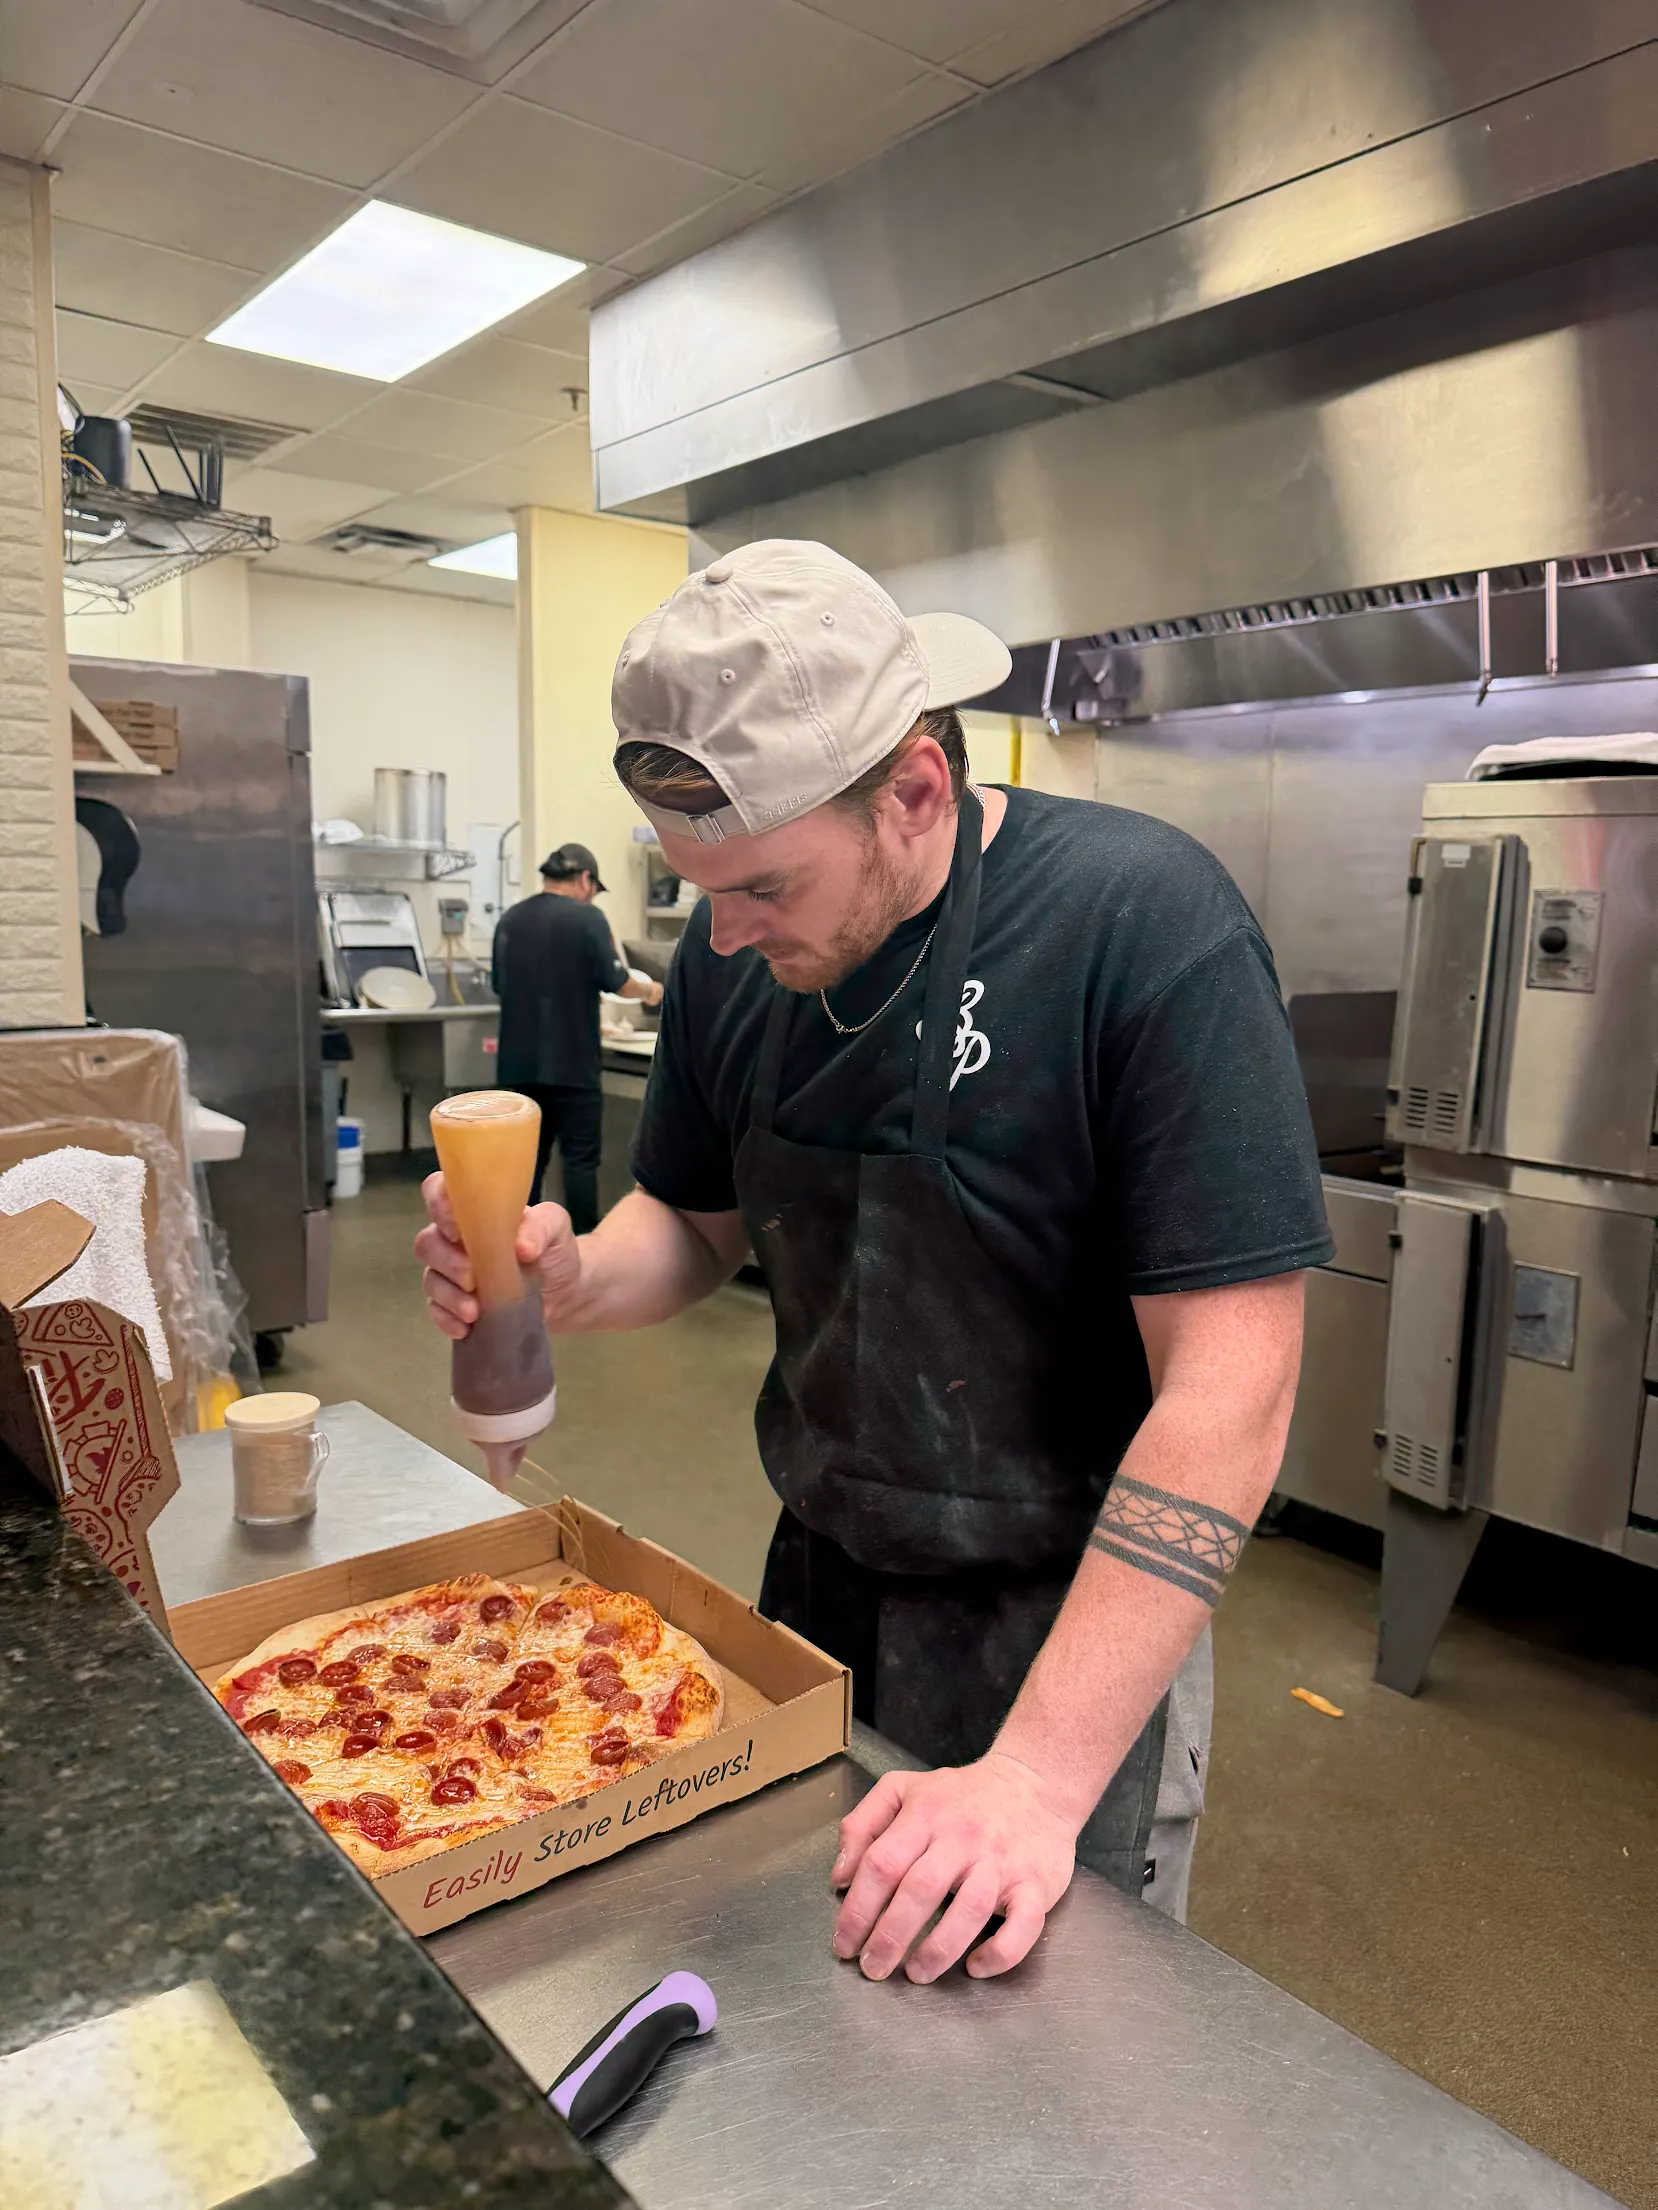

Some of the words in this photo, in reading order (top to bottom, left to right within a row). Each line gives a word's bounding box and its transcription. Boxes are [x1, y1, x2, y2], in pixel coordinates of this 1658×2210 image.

[423, 1850, 523, 1909] Easily
[533, 1816, 612, 1863] Store
[621, 1739, 754, 1826] Leftovers!
